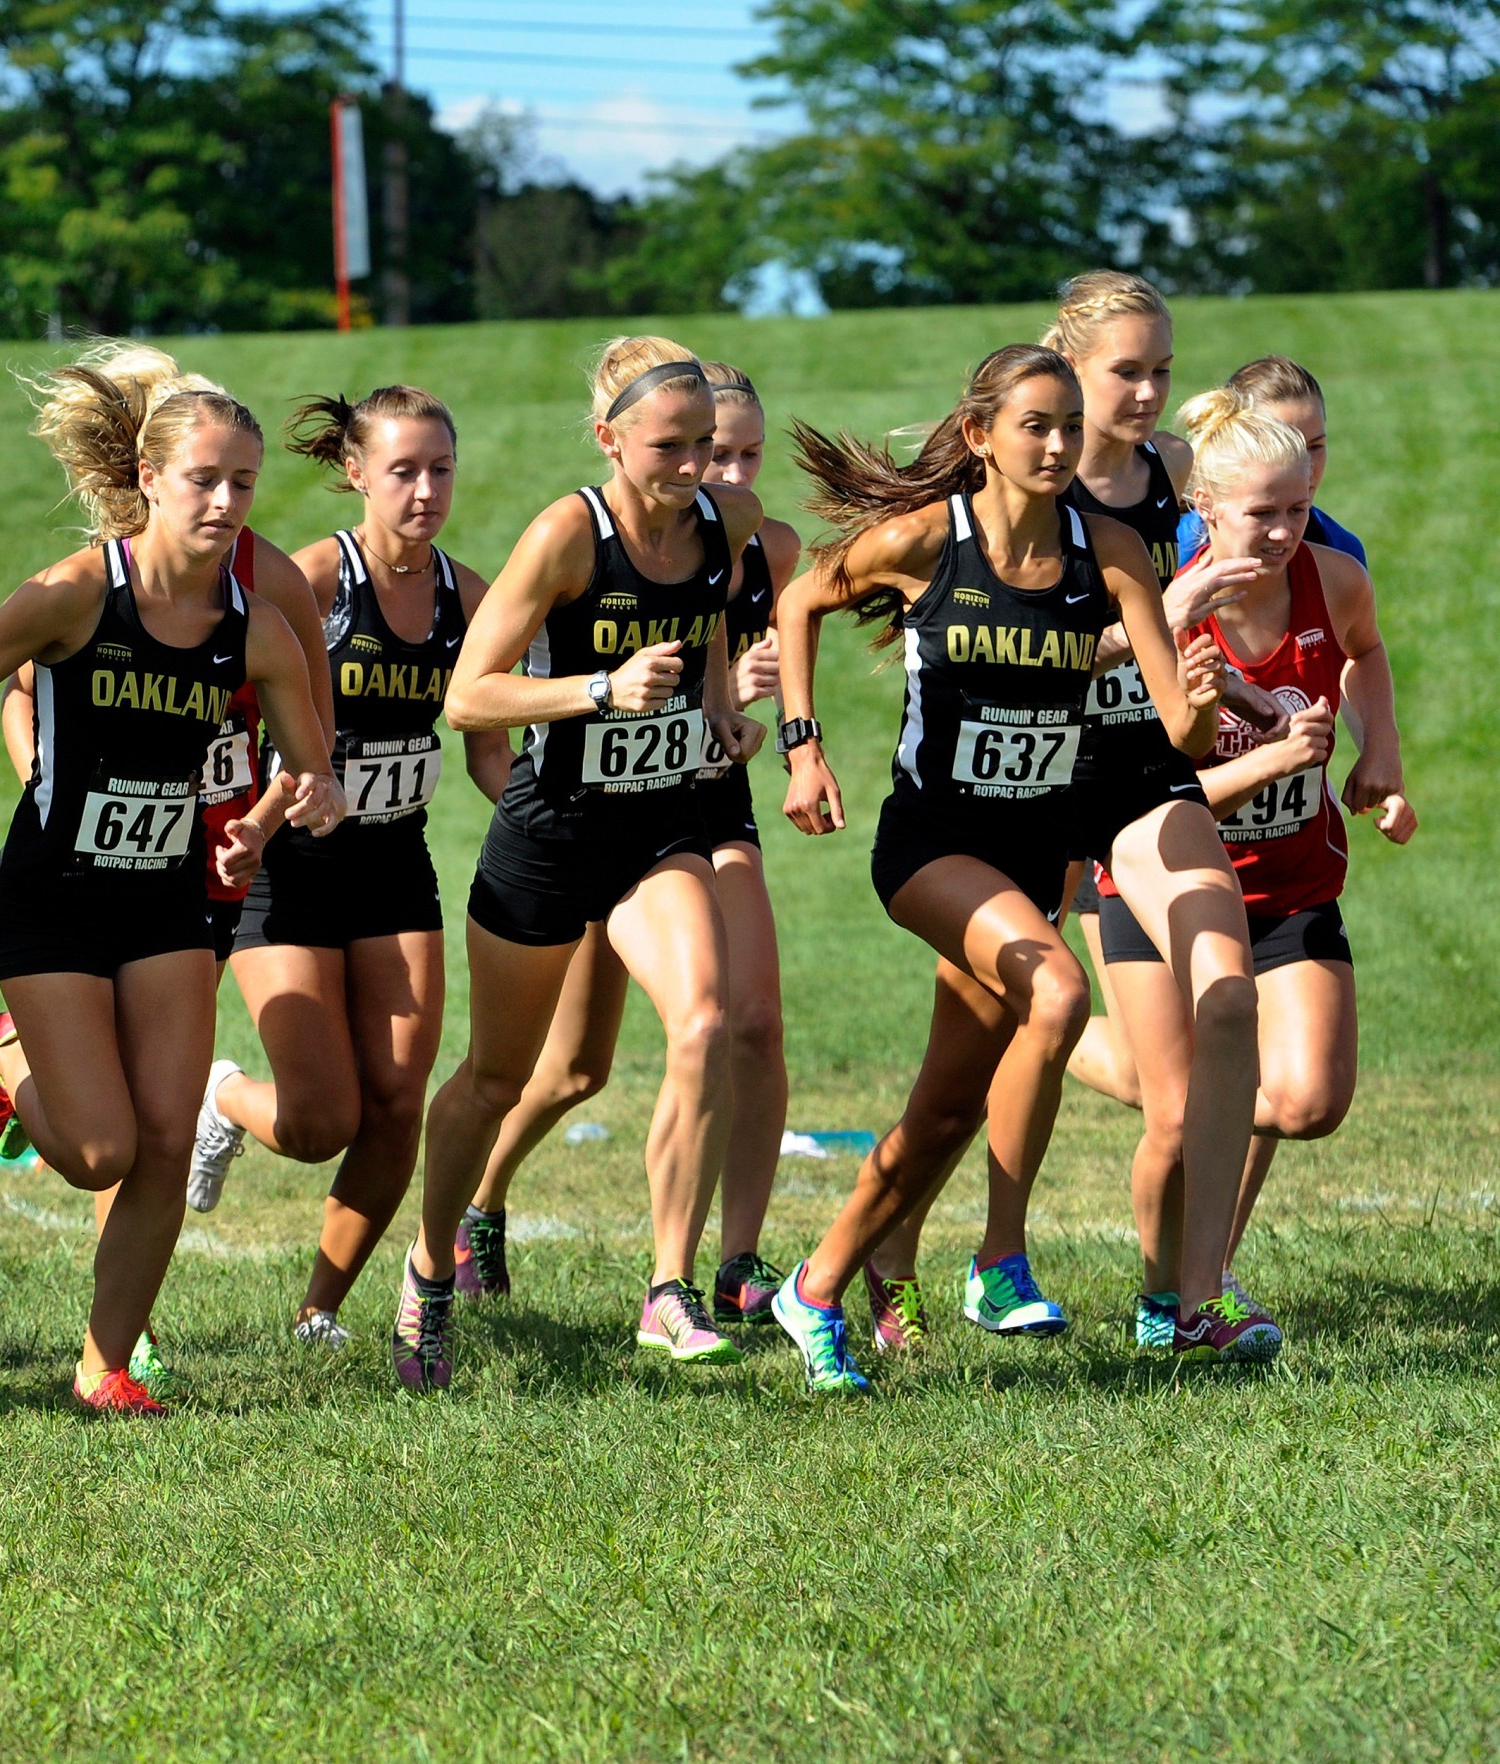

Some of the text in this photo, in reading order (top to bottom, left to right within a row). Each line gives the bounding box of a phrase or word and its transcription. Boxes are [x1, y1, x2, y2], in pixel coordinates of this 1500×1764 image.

[601, 597, 637, 606] HORIZON
[953, 591, 990, 604] HORIZON
[97, 647, 132, 658] HORIZON
[351, 638, 382, 652] HORIZON
[947, 625, 1095, 671] OAKLAND
[1096, 657, 1150, 709] 63
[980, 706, 1069, 724] RUNNIN' GEAR
[1102, 710, 1142, 726] ROTPAC
[362, 736, 432, 756] RUNNIN' GEAR
[600, 719, 689, 777] 628
[972, 729, 1066, 781] 637
[107, 777, 190, 797] RUNNIN' GEAR
[357, 758, 426, 811] 711
[604, 774, 682, 793] ROTPAC RACING
[973, 785, 1014, 798] ROTPAC
[205, 790, 234, 805] ACING
[94, 801, 185, 853] 647
[1223, 823, 1300, 842] ROTPAC RACING
[93, 855, 168, 870] ROTPAC RACING
